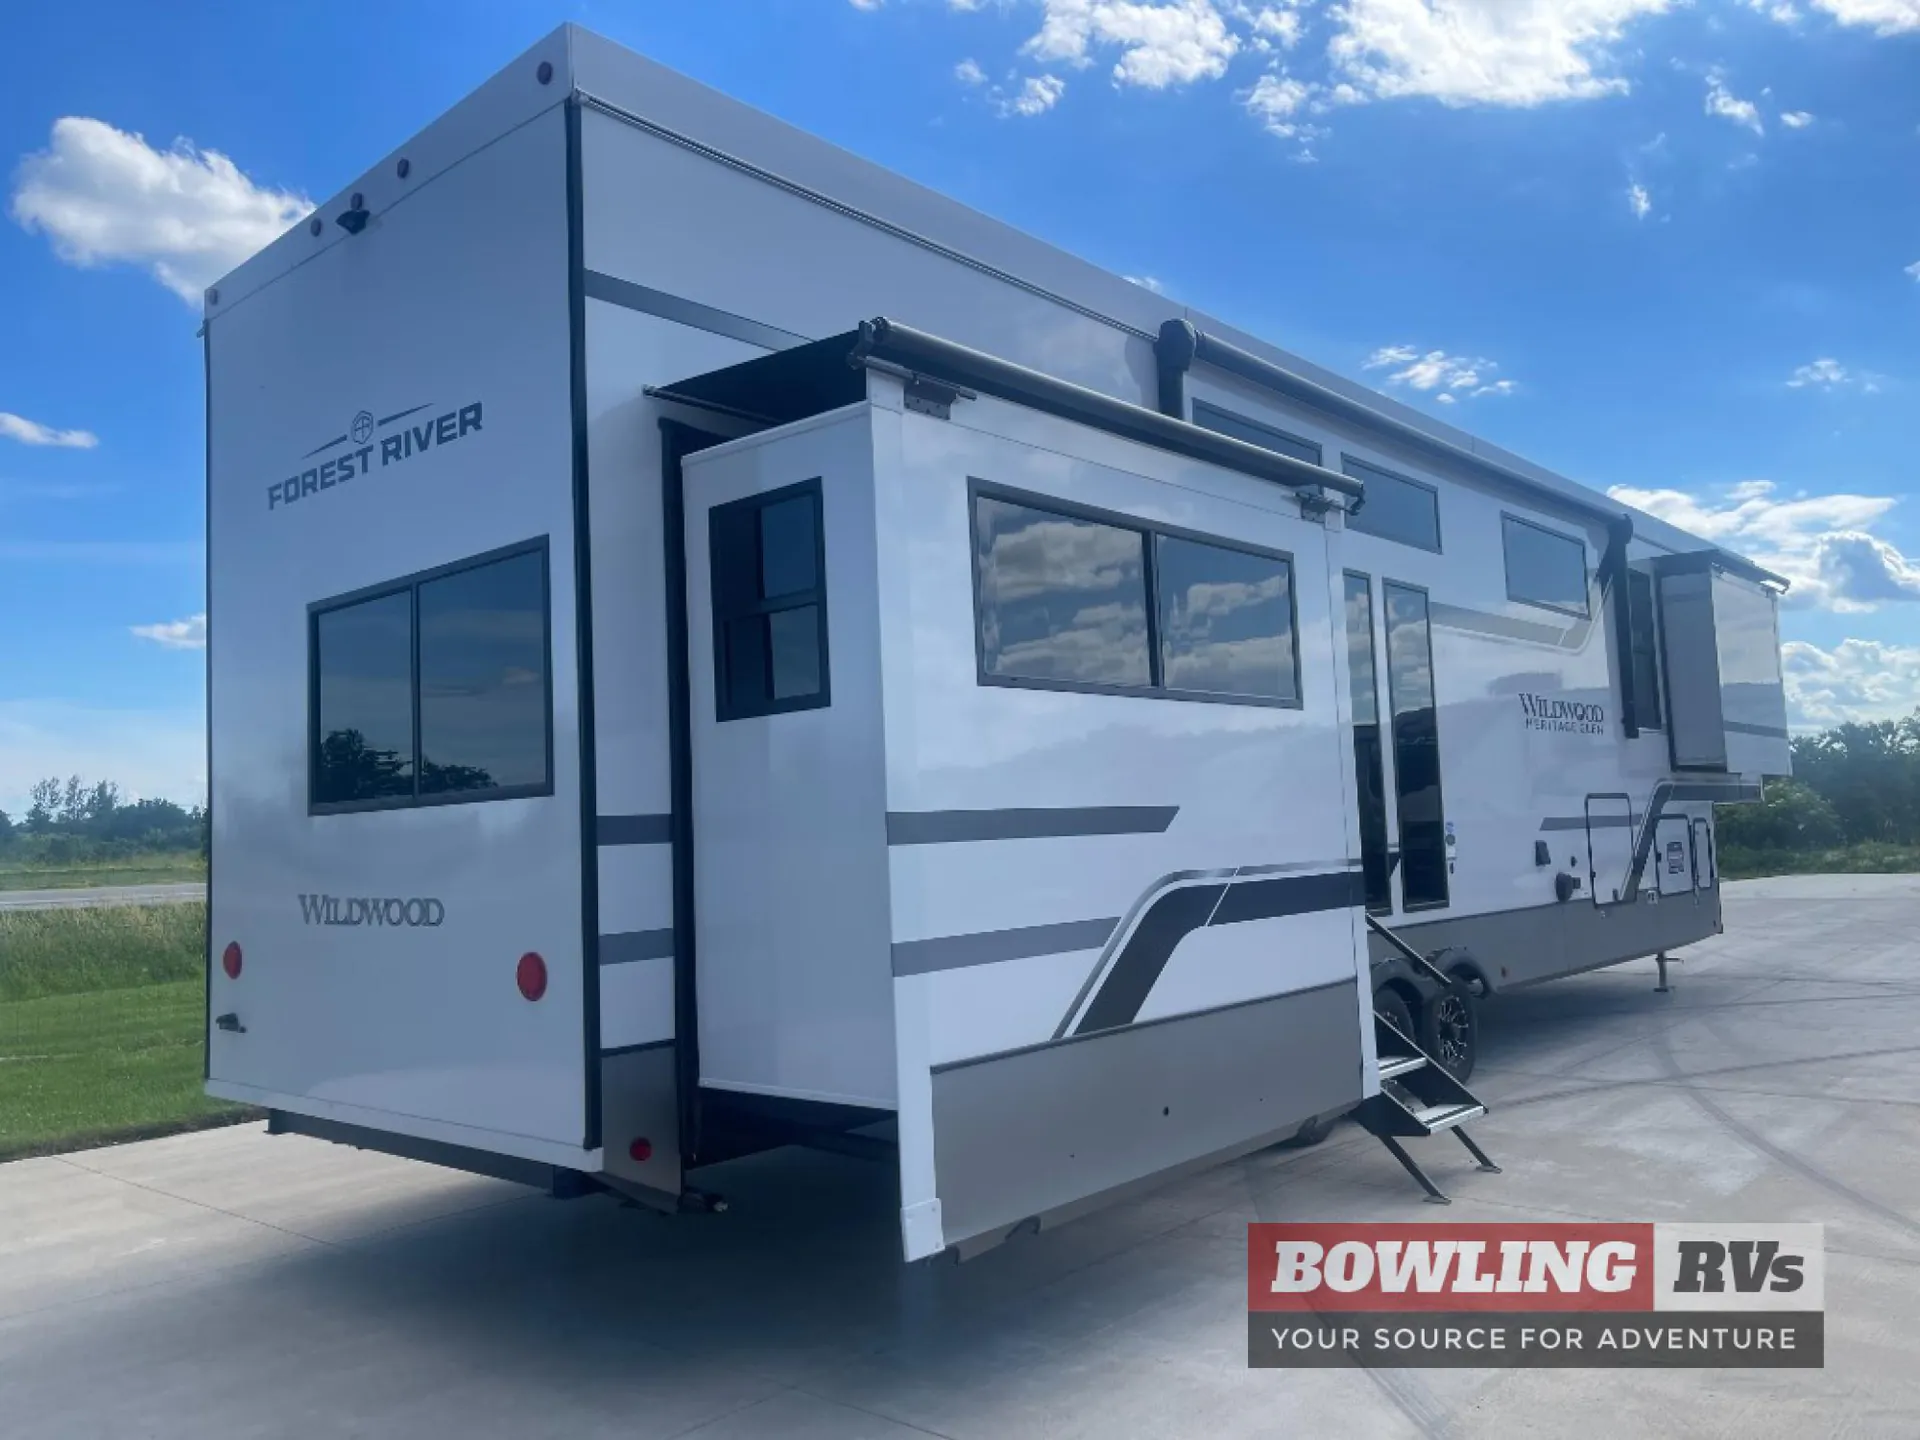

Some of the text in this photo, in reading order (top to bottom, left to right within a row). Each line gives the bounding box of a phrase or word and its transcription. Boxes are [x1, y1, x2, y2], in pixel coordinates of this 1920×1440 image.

[267, 401, 483, 511] FOREST RIVER
[298, 894, 445, 927] WILDWOOD
